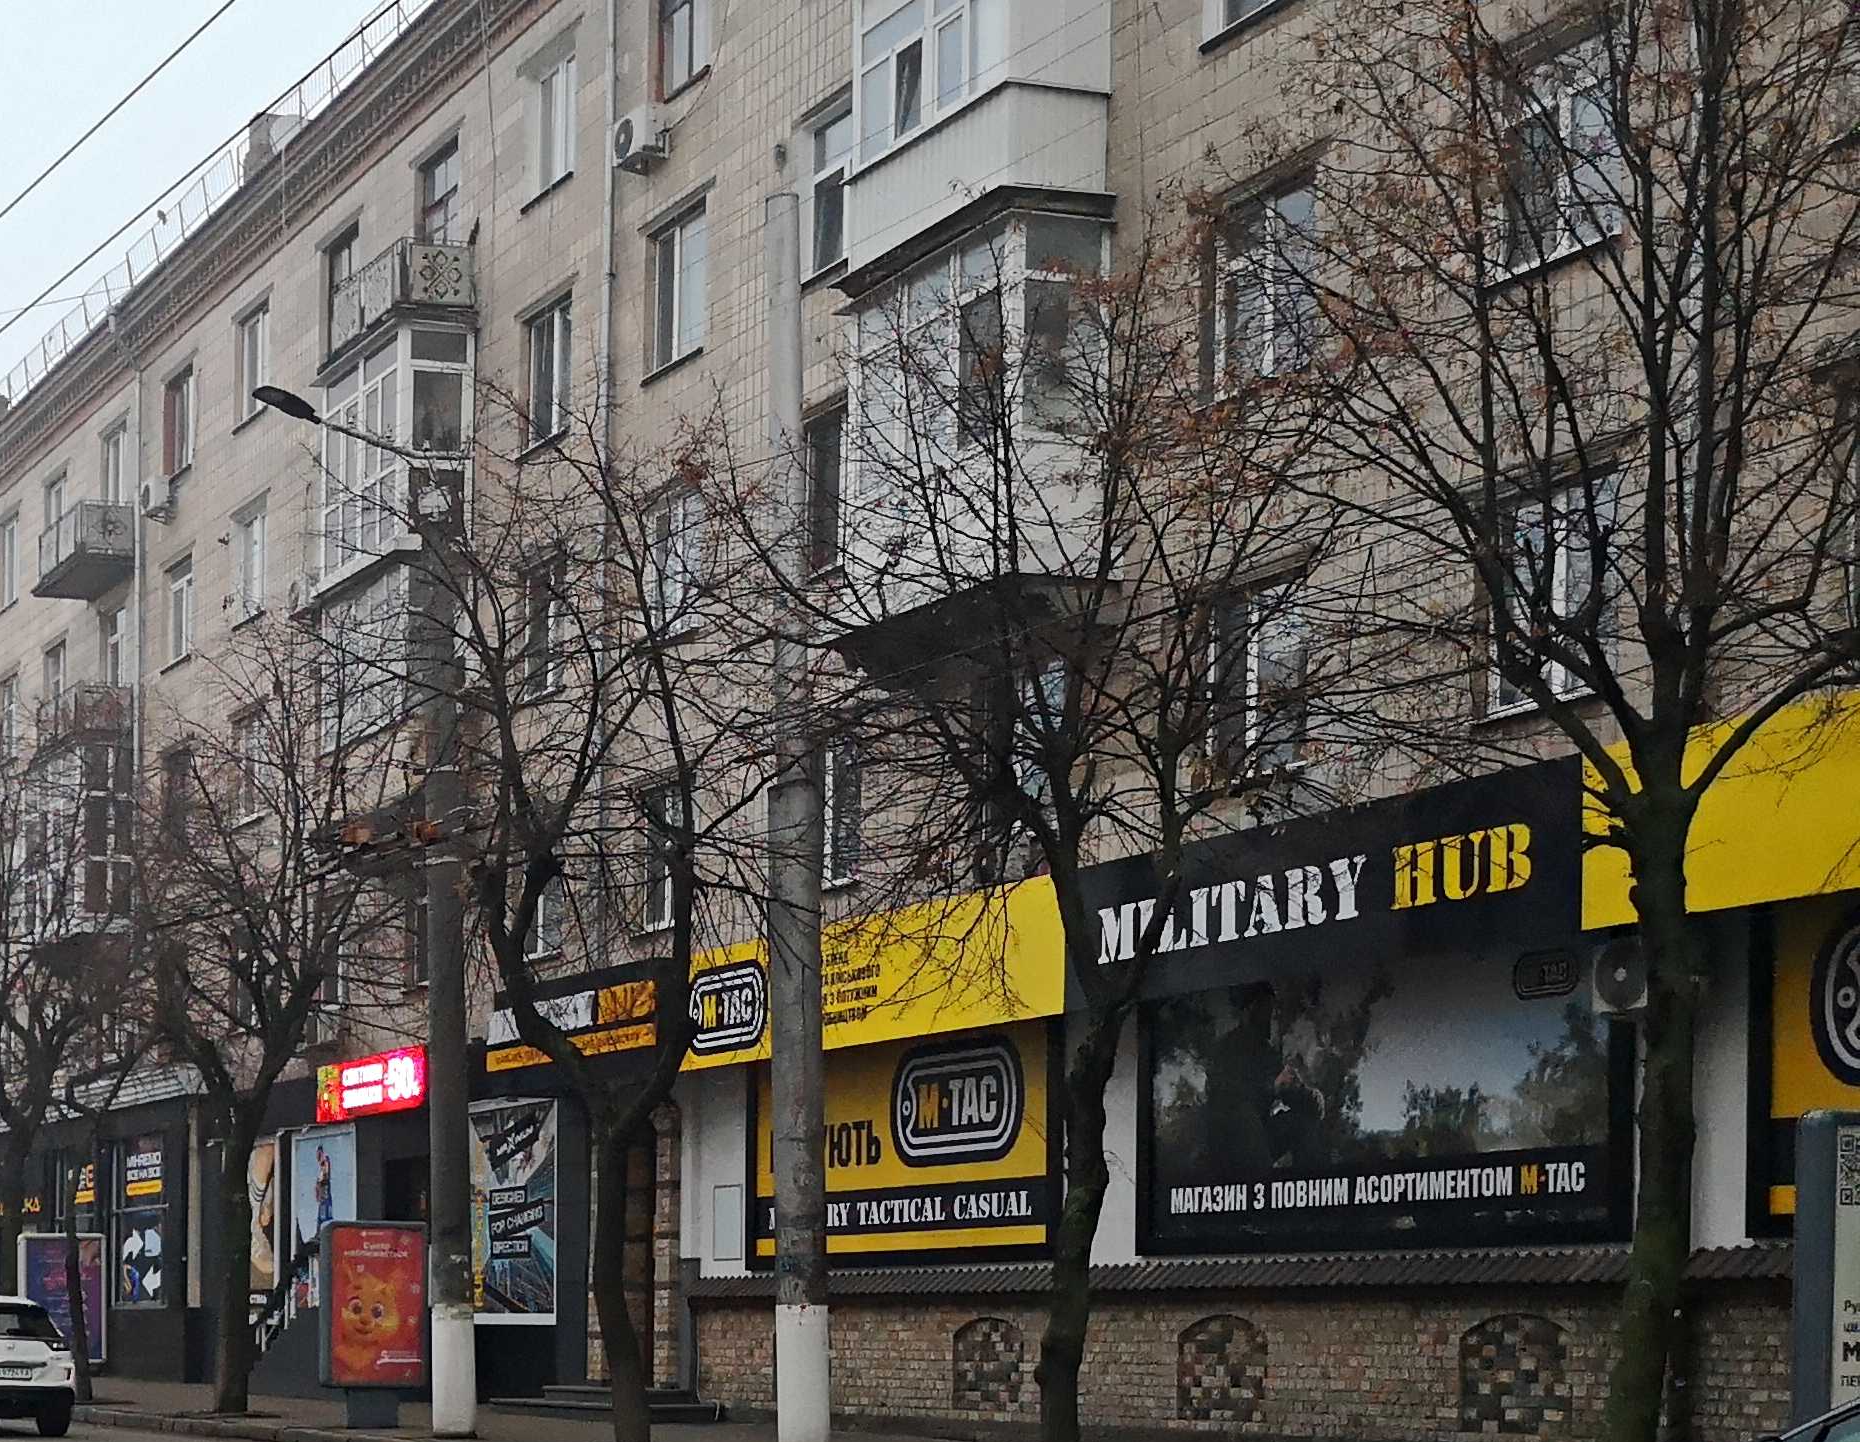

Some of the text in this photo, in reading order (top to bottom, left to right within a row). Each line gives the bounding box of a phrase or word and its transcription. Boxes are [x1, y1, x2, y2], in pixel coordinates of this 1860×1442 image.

[1390, 822, 1532, 911] HUB
[857, 1196, 946, 1227] TACTICAL
[953, 1190, 1032, 1220] CASUAL
[1169, 1184, 1247, 1214] МАГАЗИН
[1253, 1183, 1265, 1211] З
[1270, 1178, 1349, 1209] ПОВНИМ
[1353, 1166, 1513, 1206] АСОРТИМЕНТОМ
